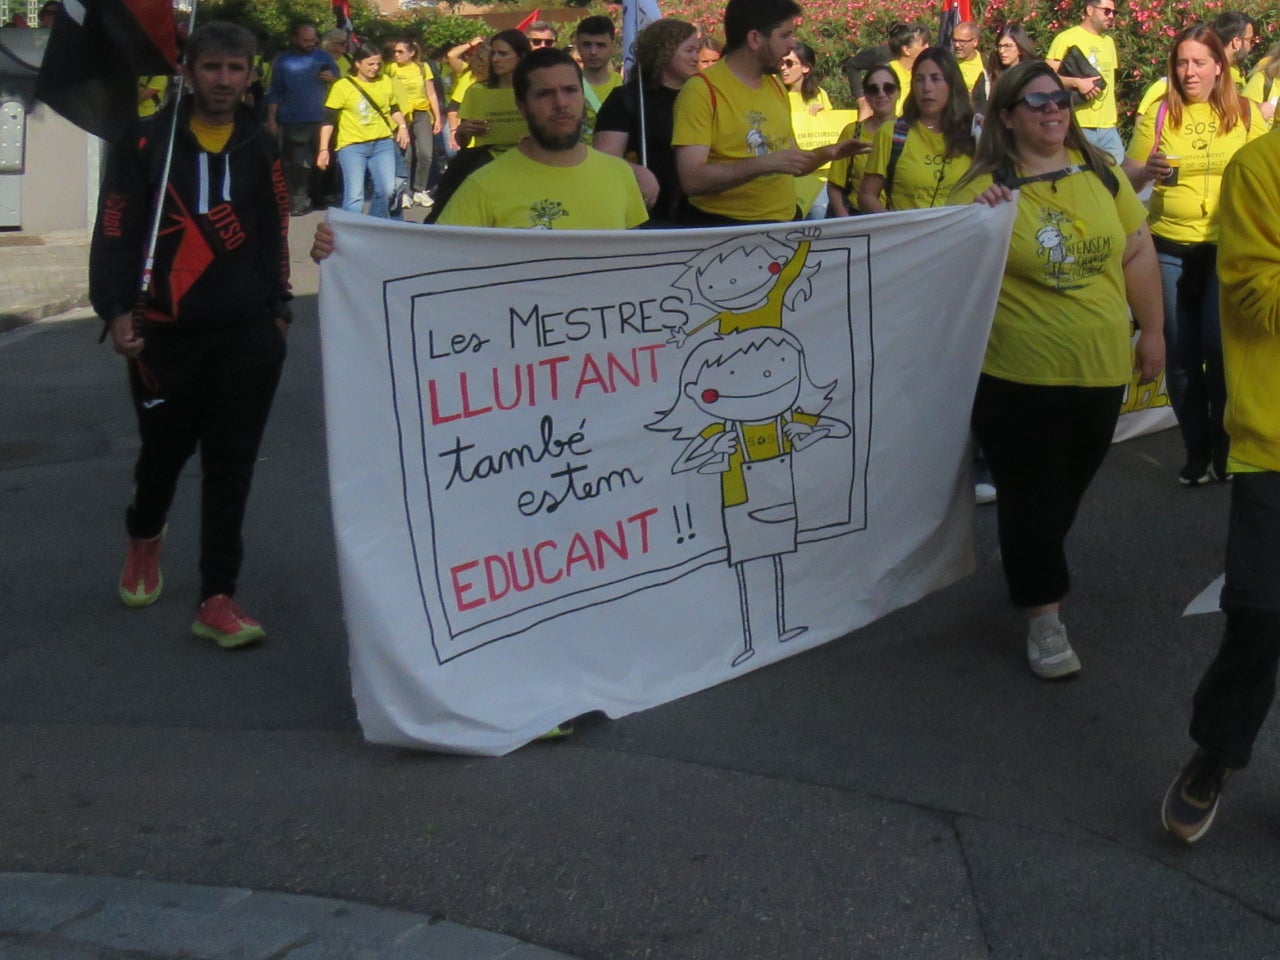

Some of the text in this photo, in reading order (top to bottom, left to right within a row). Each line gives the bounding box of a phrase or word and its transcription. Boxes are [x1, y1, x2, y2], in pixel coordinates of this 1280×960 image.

[1184, 121, 1217, 134] SOS
[207, 203, 247, 251] OTSO
[428, 295, 690, 360] Les MESTRES
[427, 343, 666, 426] LLUITANT
[439, 414, 592, 491] també
[517, 461, 644, 517] estem
[450, 506, 659, 612] EDUCANT
